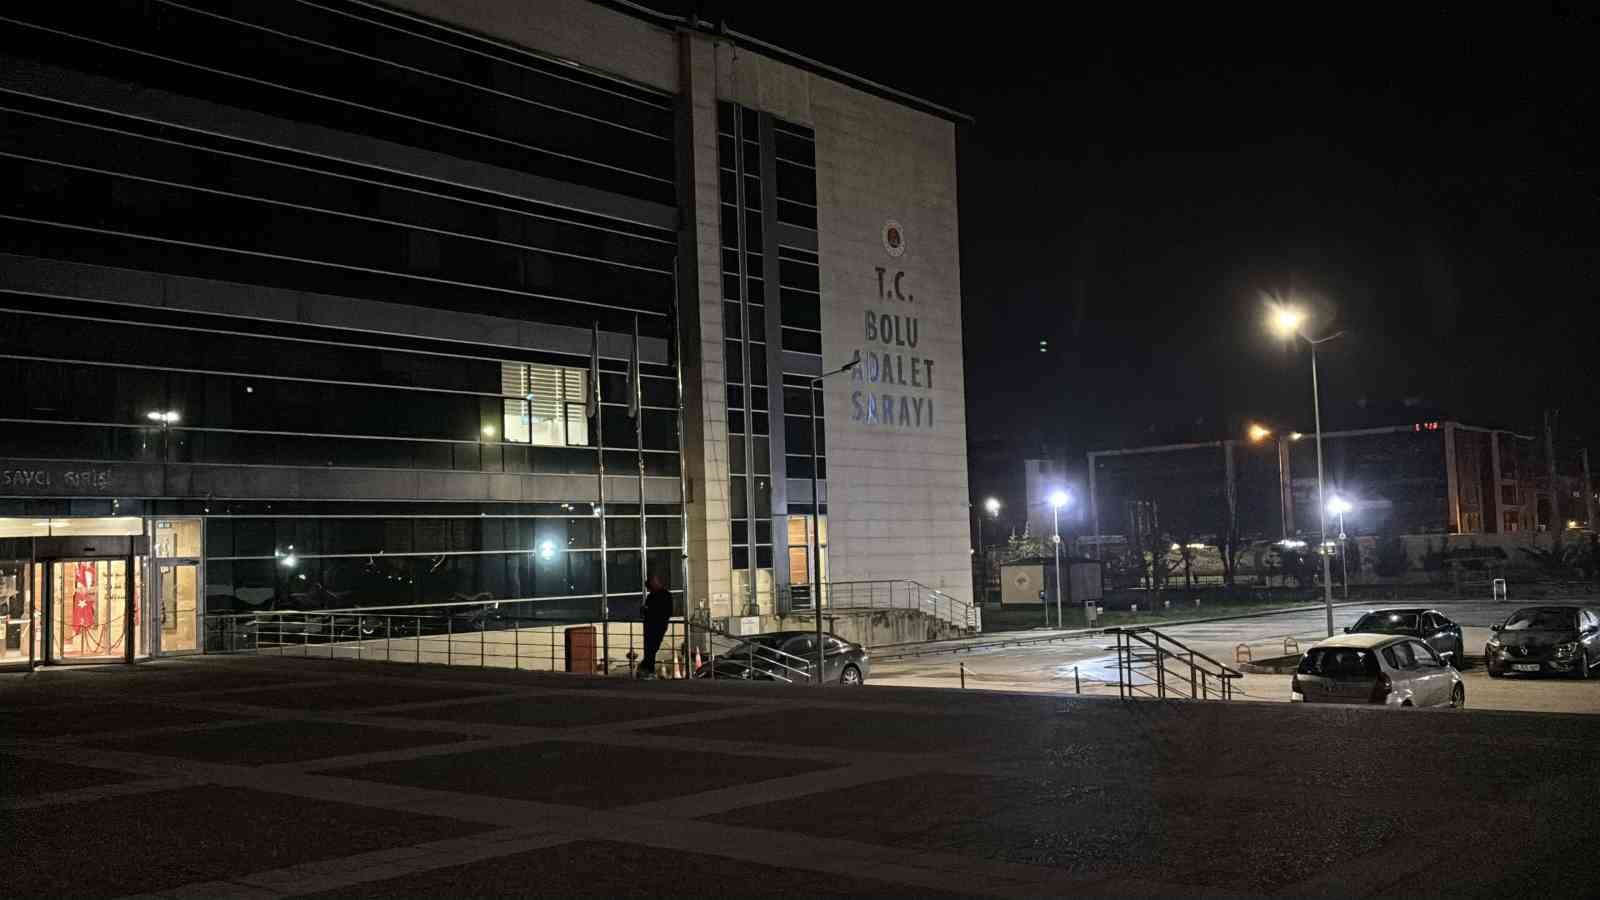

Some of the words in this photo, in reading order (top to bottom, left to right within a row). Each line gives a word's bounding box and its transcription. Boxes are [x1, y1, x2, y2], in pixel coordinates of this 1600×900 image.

[875, 267, 914, 302] T.C.
[865, 310, 918, 348] BOLU
[852, 350, 934, 388] ADALET
[852, 391, 933, 428] SARAYI
